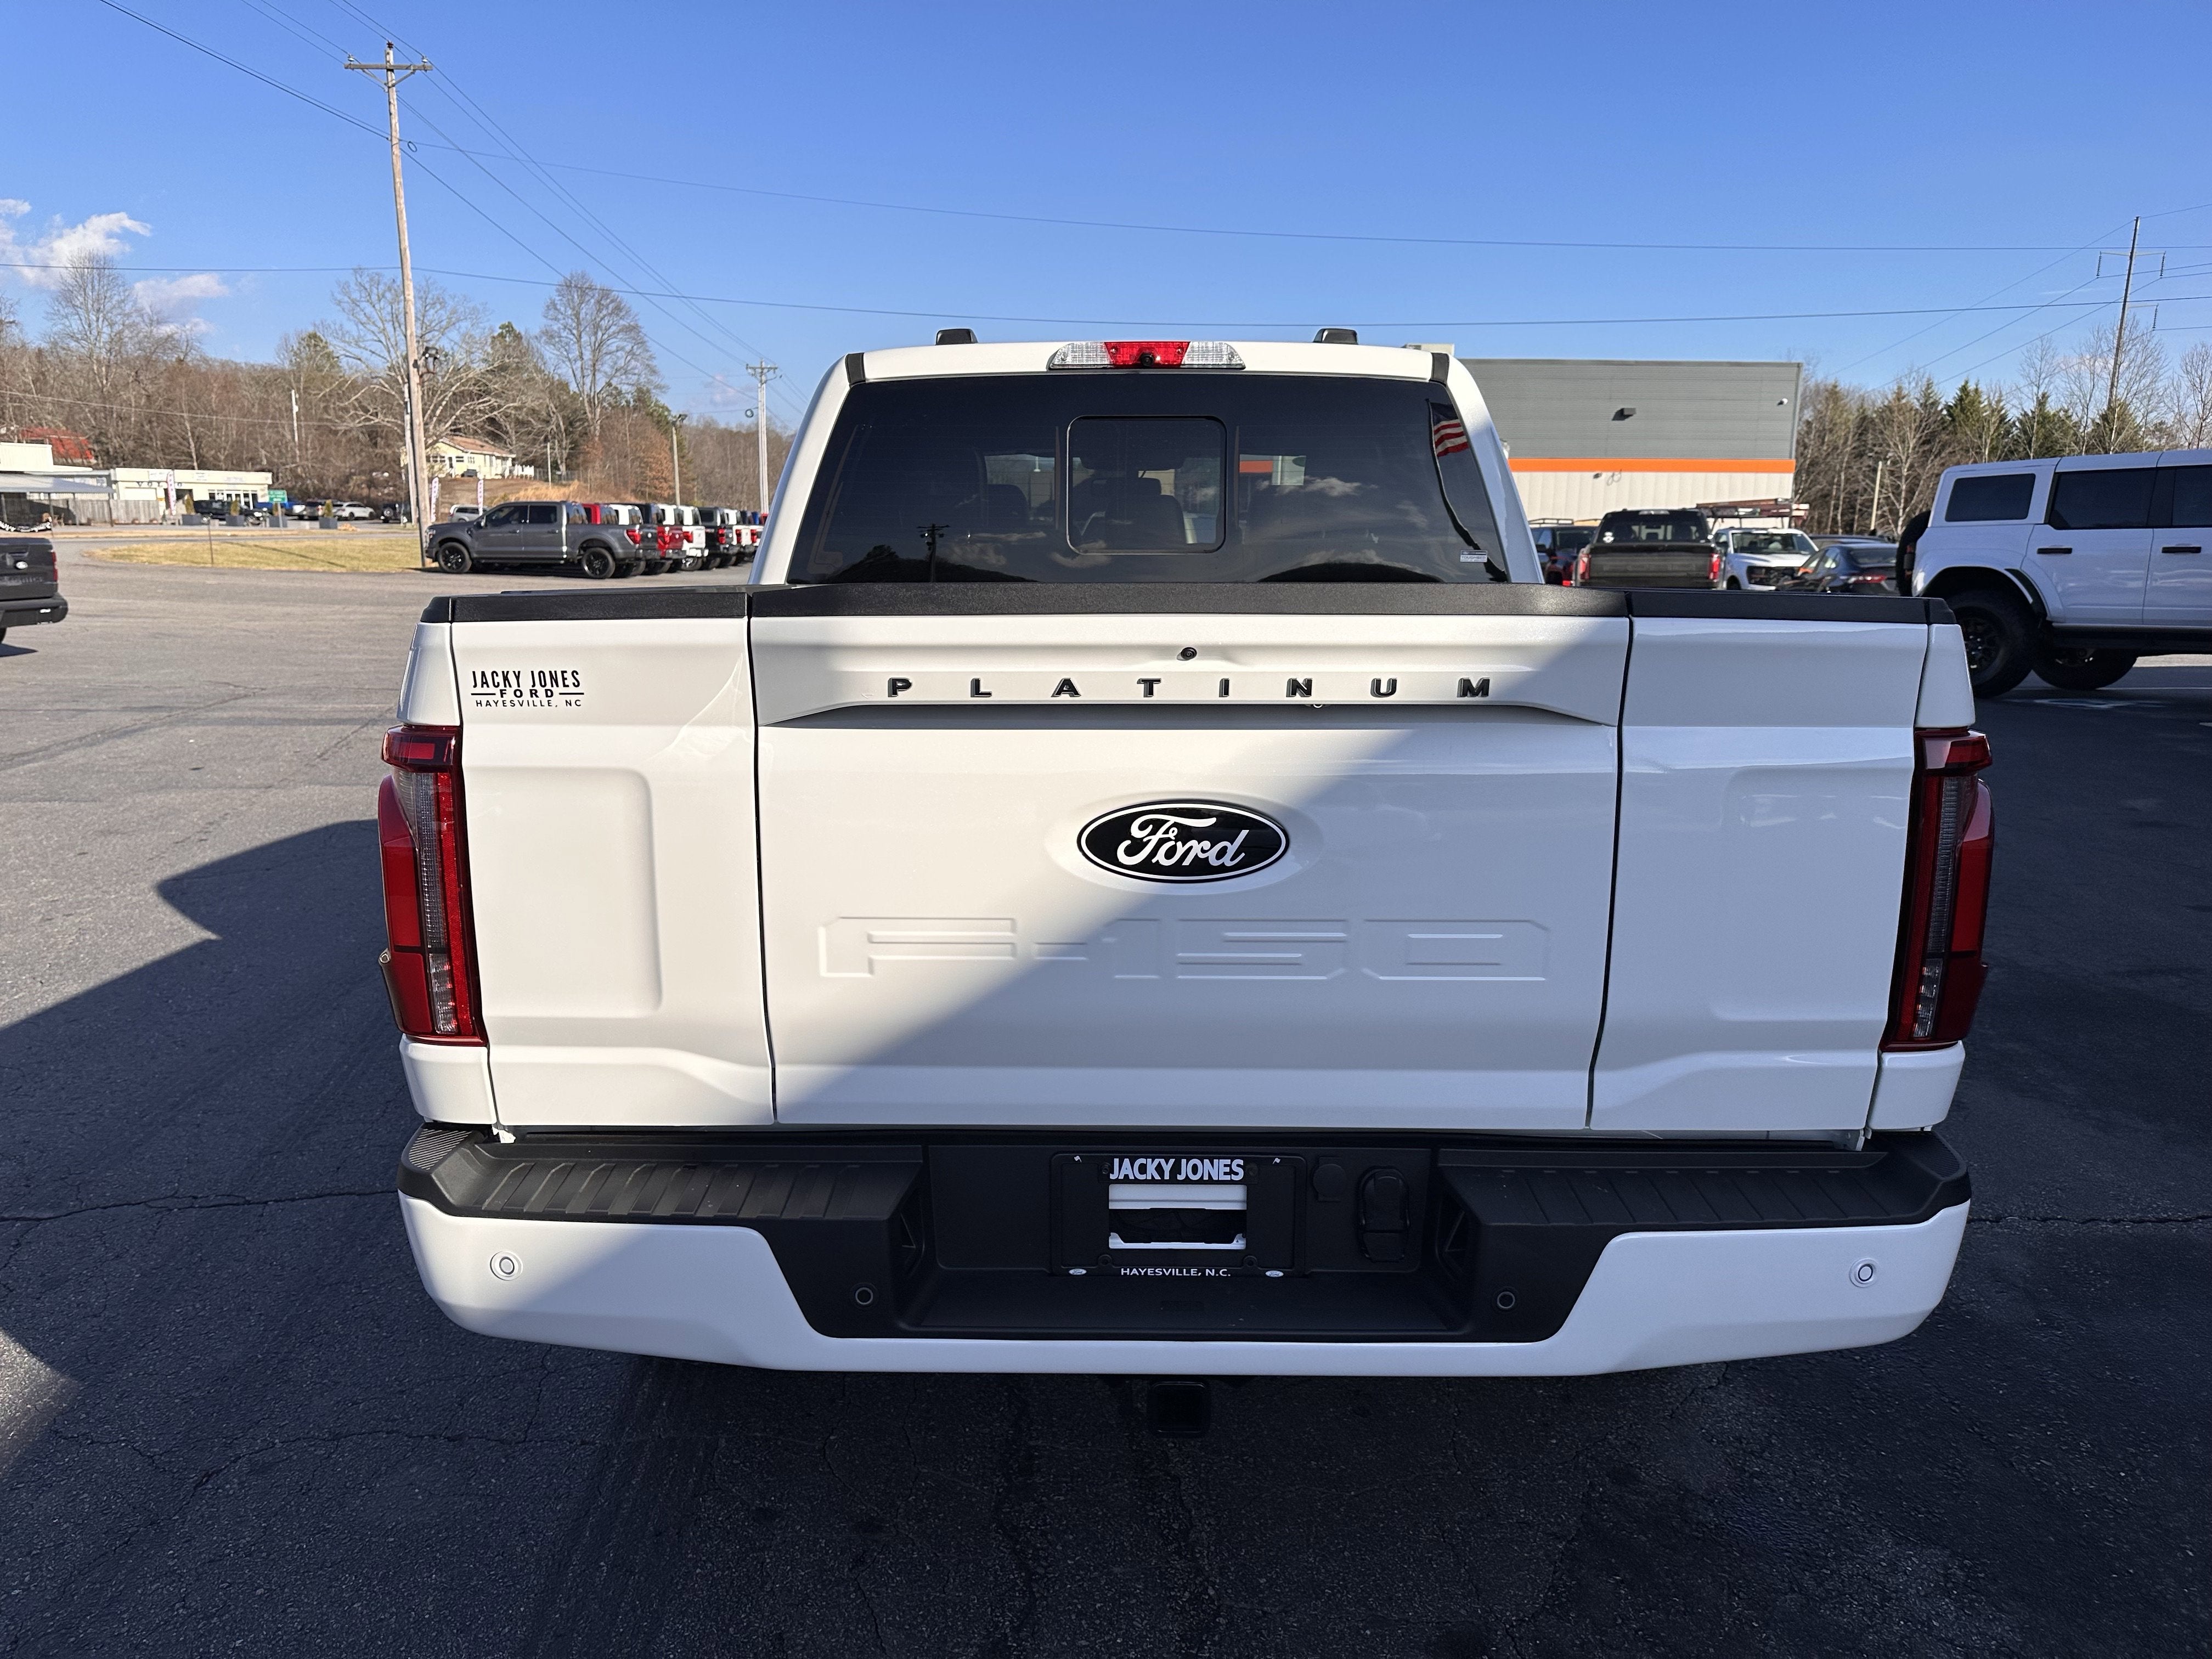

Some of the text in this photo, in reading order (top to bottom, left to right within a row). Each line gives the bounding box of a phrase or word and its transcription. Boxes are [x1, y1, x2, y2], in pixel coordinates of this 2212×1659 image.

[472, 670, 580, 688] JACKY JONES
[888, 677, 1490, 698] PLATINUM
[499, 689, 554, 698] FORD
[476, 699, 558, 708] HAYESVILLE,
[1116, 814, 1250, 867] Ford
[817, 917, 1550, 981] F-150
[1109, 1158, 1244, 1181] JACKY JONES
[1121, 1268, 1201, 1277] HAYESVILLE,
